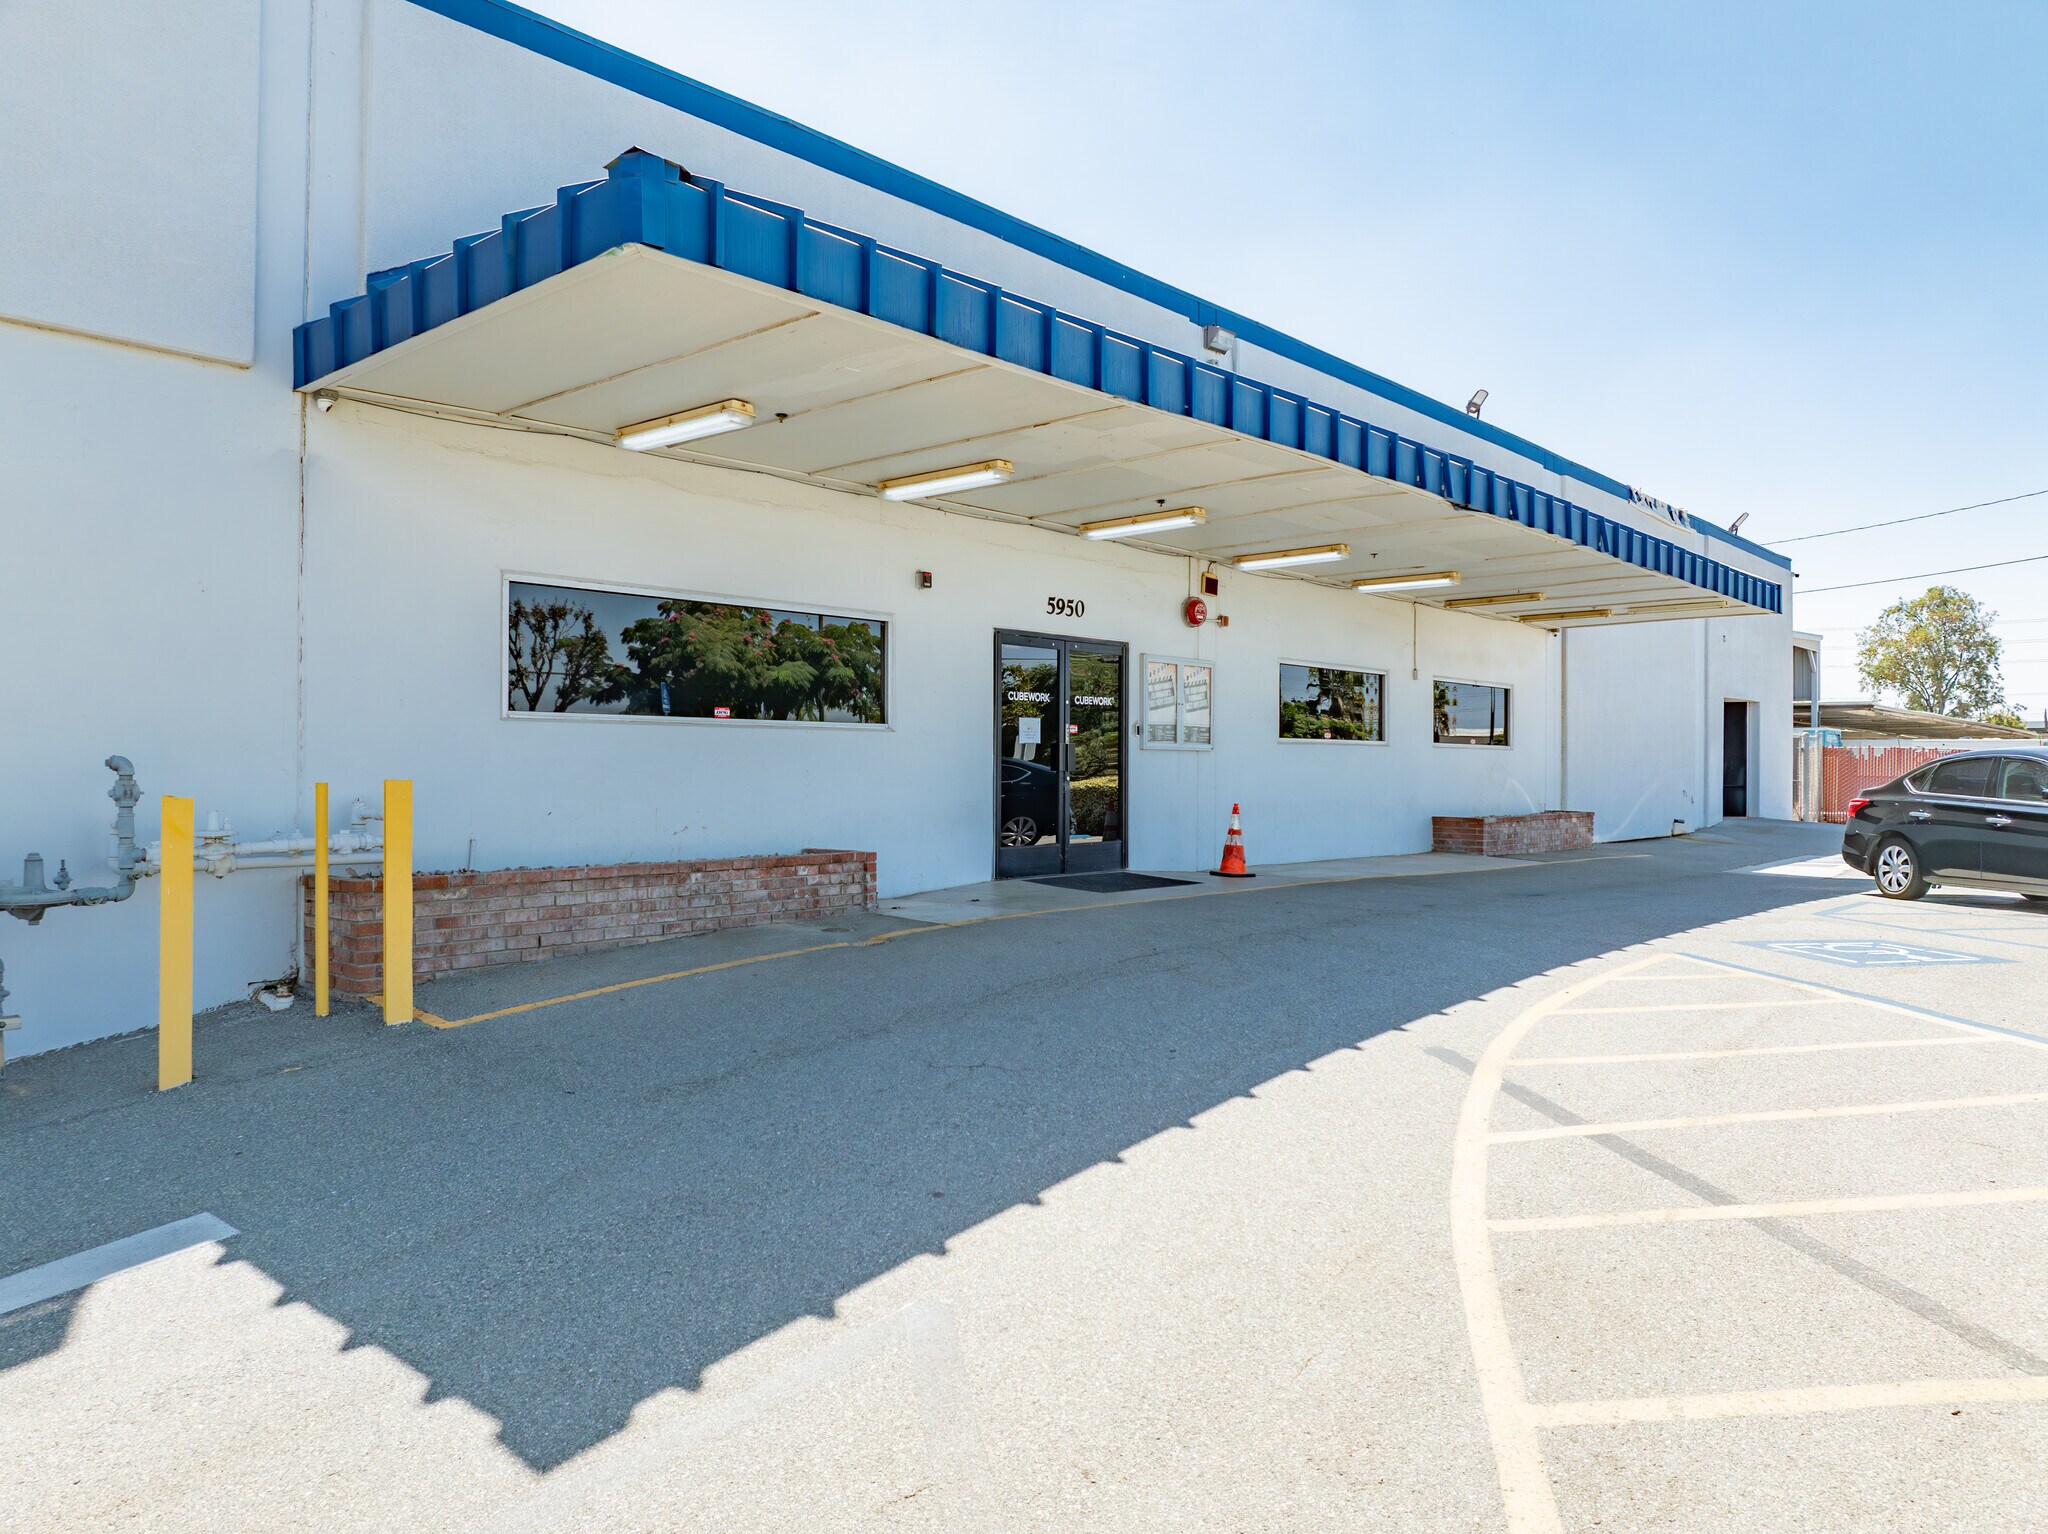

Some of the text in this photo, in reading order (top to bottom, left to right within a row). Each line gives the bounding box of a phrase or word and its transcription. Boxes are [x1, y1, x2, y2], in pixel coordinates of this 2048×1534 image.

[1046, 596, 1085, 618] 5950
[1007, 691, 1051, 703] CUBEWORK
[1074, 695, 1113, 706] CUBEWORK
